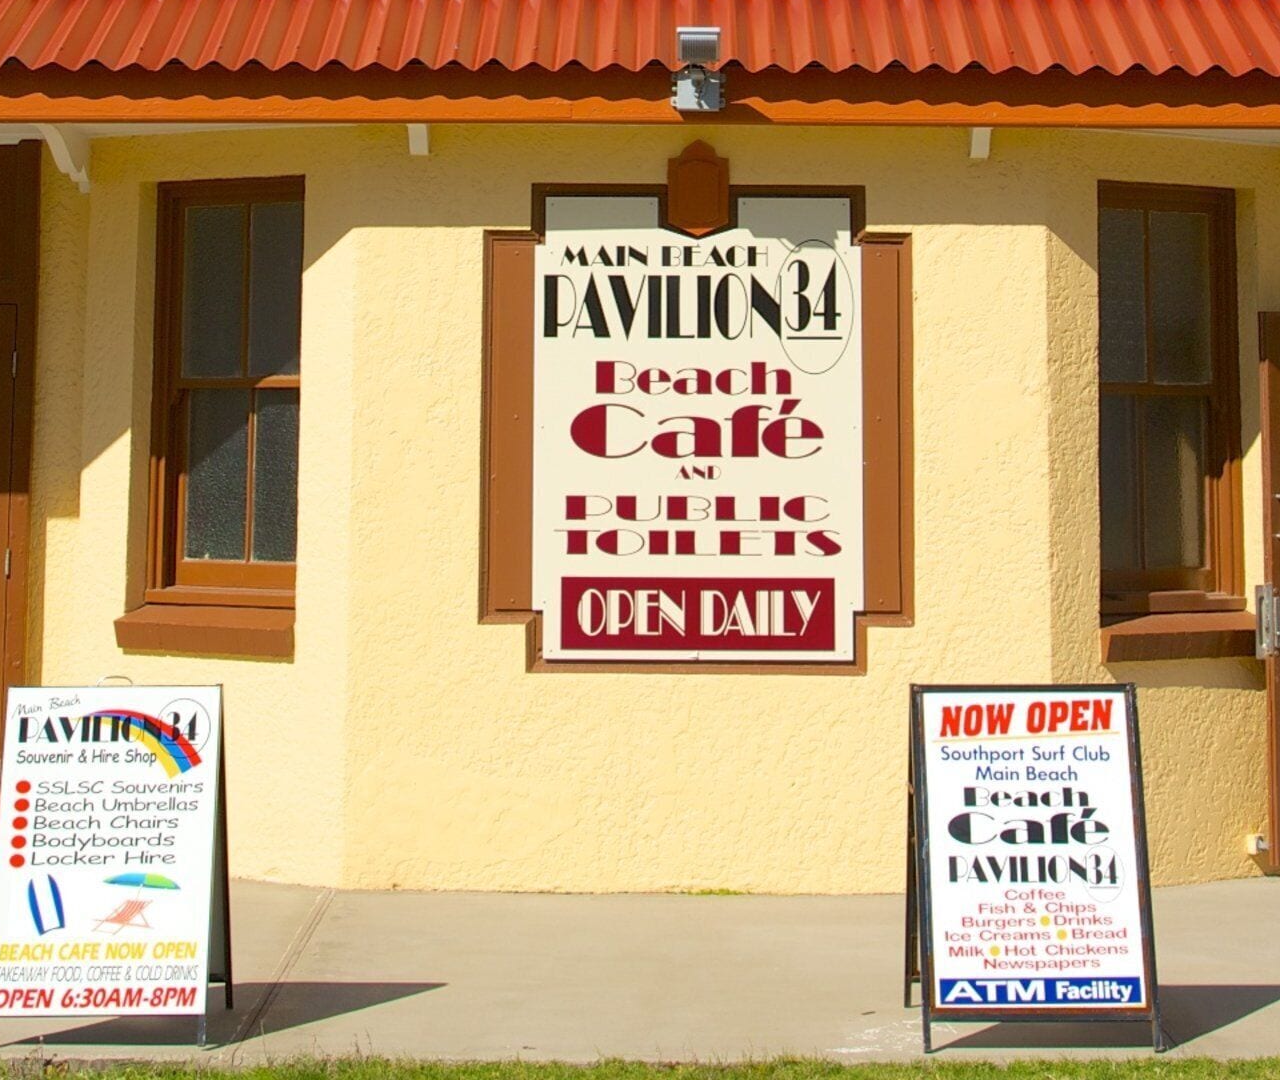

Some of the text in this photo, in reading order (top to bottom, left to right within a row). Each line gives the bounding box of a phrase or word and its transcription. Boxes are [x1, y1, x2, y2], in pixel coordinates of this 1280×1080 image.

[560, 244, 769, 266] MAIN BEACH
[595, 360, 792, 395] Beach
[570, 399, 825, 459] Café
[675, 465, 722, 480] AND
[565, 495, 830, 522] PUBLIC
[554, 529, 843, 557] TOILETS
[577, 588, 822, 637] OPEN DAILY
[12, 694, 80, 719] Main Beach
[940, 699, 1113, 737] NOW OPEN
[16, 749, 156, 766] Souvenir & Hire Shop
[941, 745, 1110, 763] Southport Surf Club
[976, 766, 1078, 781] Main Beach
[37, 780, 204, 795] SSLSC Souvenirs
[35, 797, 199, 812] Beach Umbrellas
[964, 787, 1089, 807] Beach
[33, 816, 179, 829] Beach Chairs
[948, 808, 1109, 844] Café
[32, 833, 175, 851] Bodyboards
[31, 851, 176, 866] Locker Hire
[1005, 889, 1066, 901] Coffee
[978, 902, 1097, 915] Fish & Chips
[962, 915, 1113, 929] Burgers Drinks
[945, 928, 1127, 941] Ice Creams Bread
[58, 943, 100, 960] CAFE
[105, 942, 147, 959] NOW
[153, 942, 197, 959] OPEN
[949, 944, 1129, 957] Milk Hot Chickens
[984, 958, 1100, 971] Newspapers
[51, 966, 83, 983] FOOD,
[87, 966, 121, 982] COFFEE
[125, 966, 132, 981] &
[136, 965, 162, 981] COLD
[165, 965, 198, 981] DRINKS
[61, 987, 196, 1007] 6:30AM-8PM
[944, 980, 1132, 1002] ATM Facility
